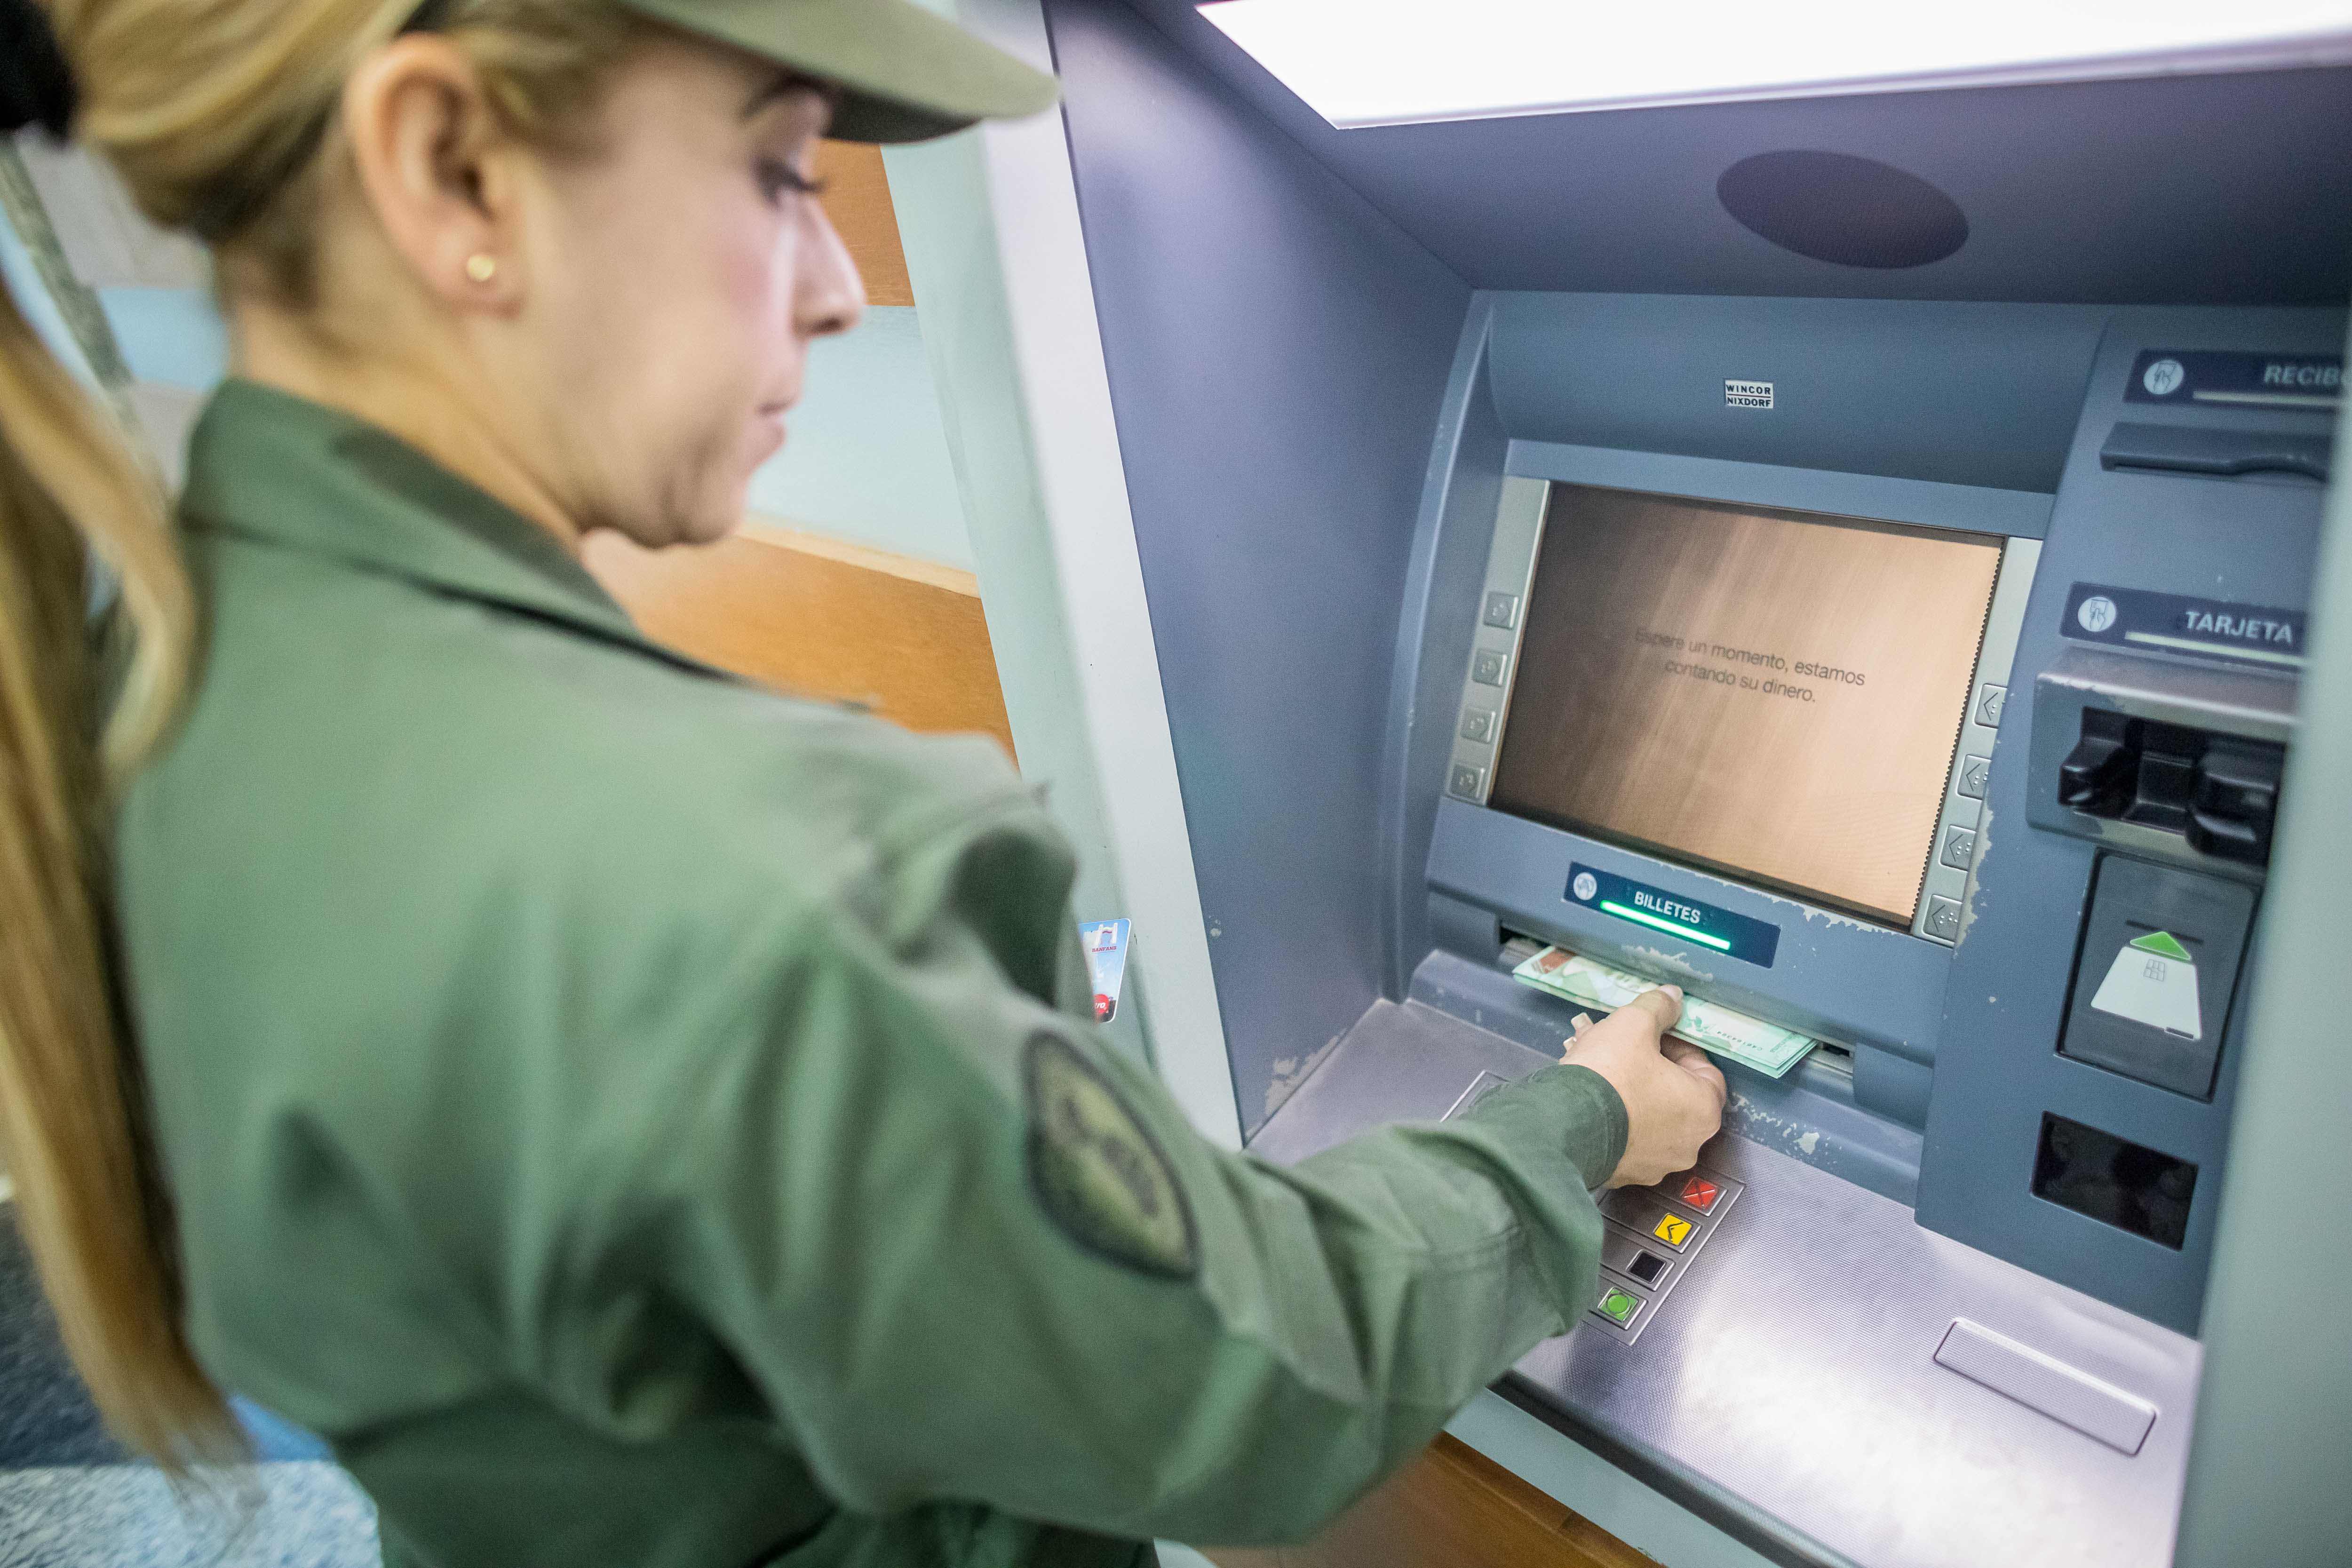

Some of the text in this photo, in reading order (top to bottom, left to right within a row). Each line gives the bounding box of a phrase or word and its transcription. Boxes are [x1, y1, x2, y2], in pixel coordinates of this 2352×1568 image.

[1726, 384, 1771, 394] WINCOR
[2264, 365, 2341, 385] RECIB
[1727, 397, 1771, 406] NIXDORF
[2185, 611, 2293, 644] TARJETA
[1688, 640, 1708, 653] un
[1711, 643, 1788, 673] momento,
[1794, 660, 1866, 686] estamos
[1664, 658, 1816, 703] contando su dinero.
[1634, 891, 1700, 923] BILLETES
